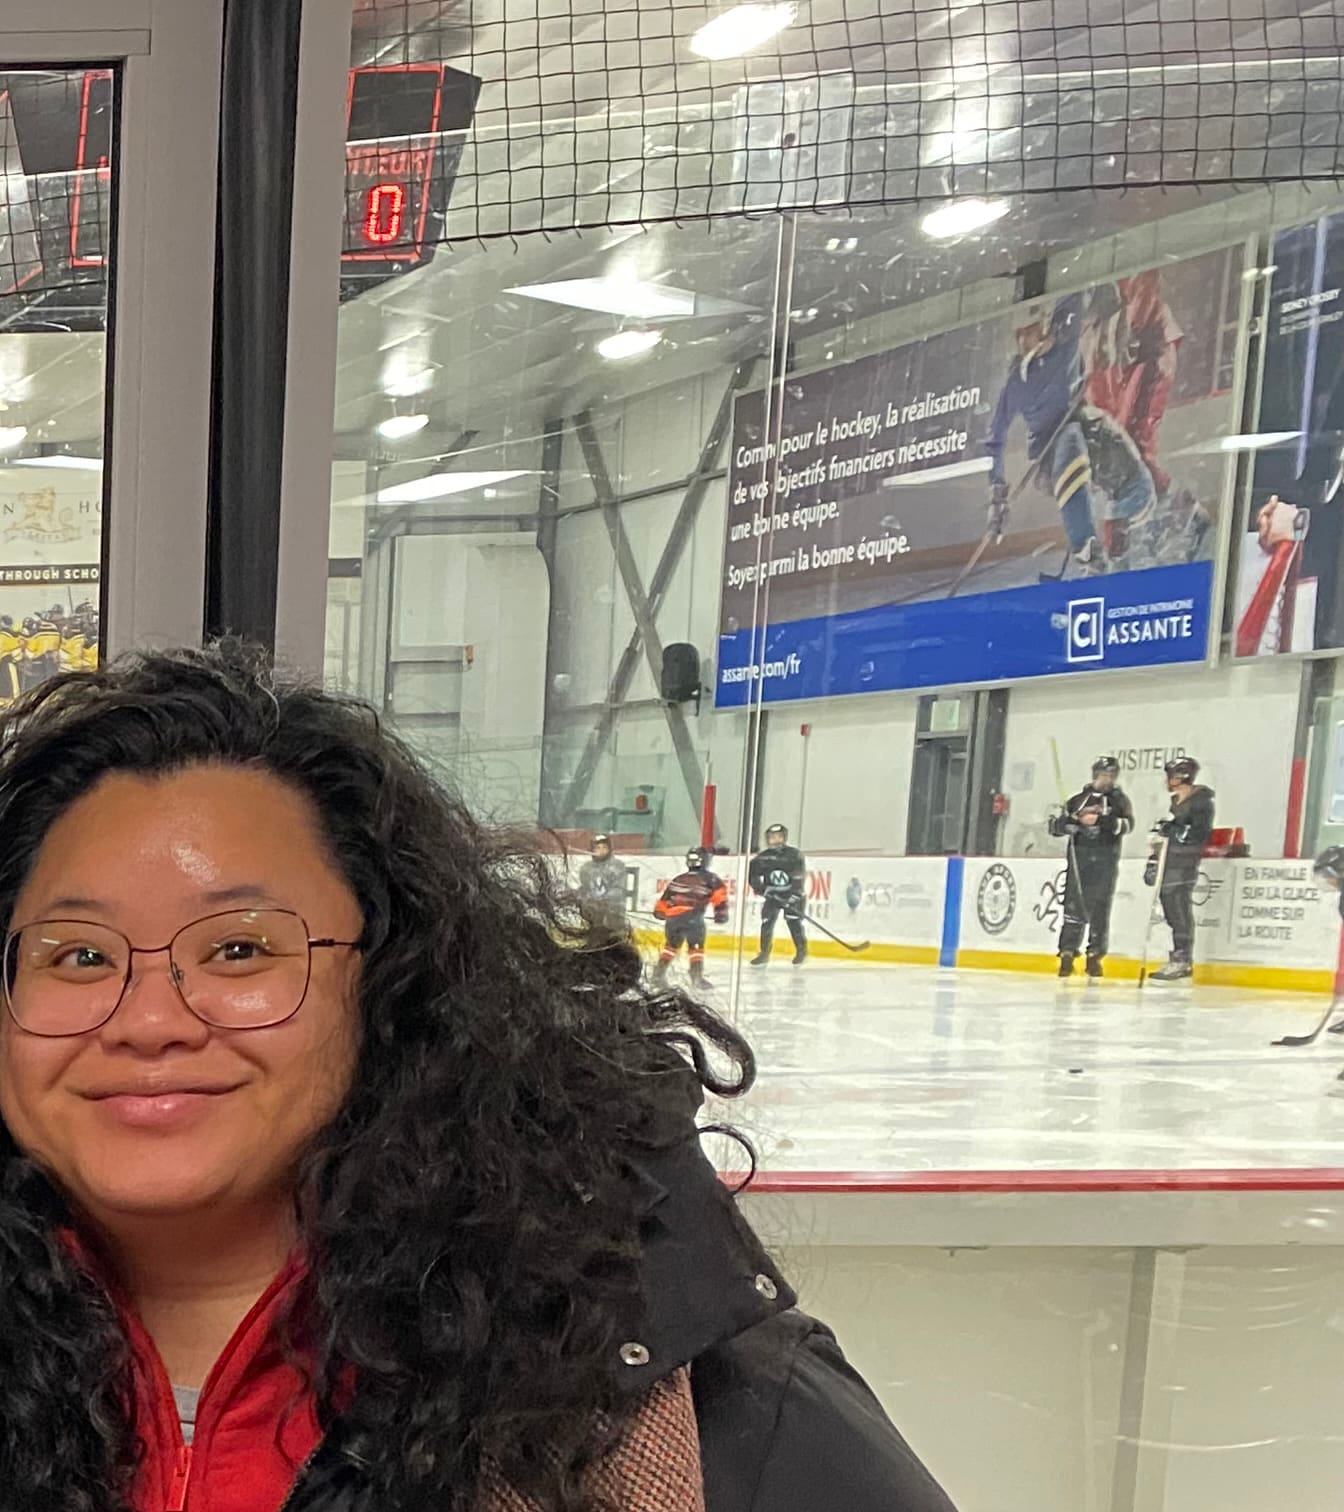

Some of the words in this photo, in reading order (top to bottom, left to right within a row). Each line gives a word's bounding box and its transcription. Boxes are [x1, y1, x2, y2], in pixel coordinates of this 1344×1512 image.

[369, 185, 402, 241] 0
[780, 431, 814, 462] pour
[815, 422, 828, 447] le
[830, 411, 882, 442] hockey,
[885, 402, 899, 428] la
[902, 385, 981, 424] réalisation
[734, 481, 748, 505] de
[776, 462, 826, 498] bjectifs
[829, 448, 895, 482] financiers
[898, 429, 968, 465] nécessite
[731, 521, 751, 541] une
[792, 500, 840, 530] équipe.
[798, 548, 810, 571] la
[812, 545, 854, 569] bonne
[858, 532, 911, 566] équipe.
[1107, 614, 1192, 645] ASSANTE
